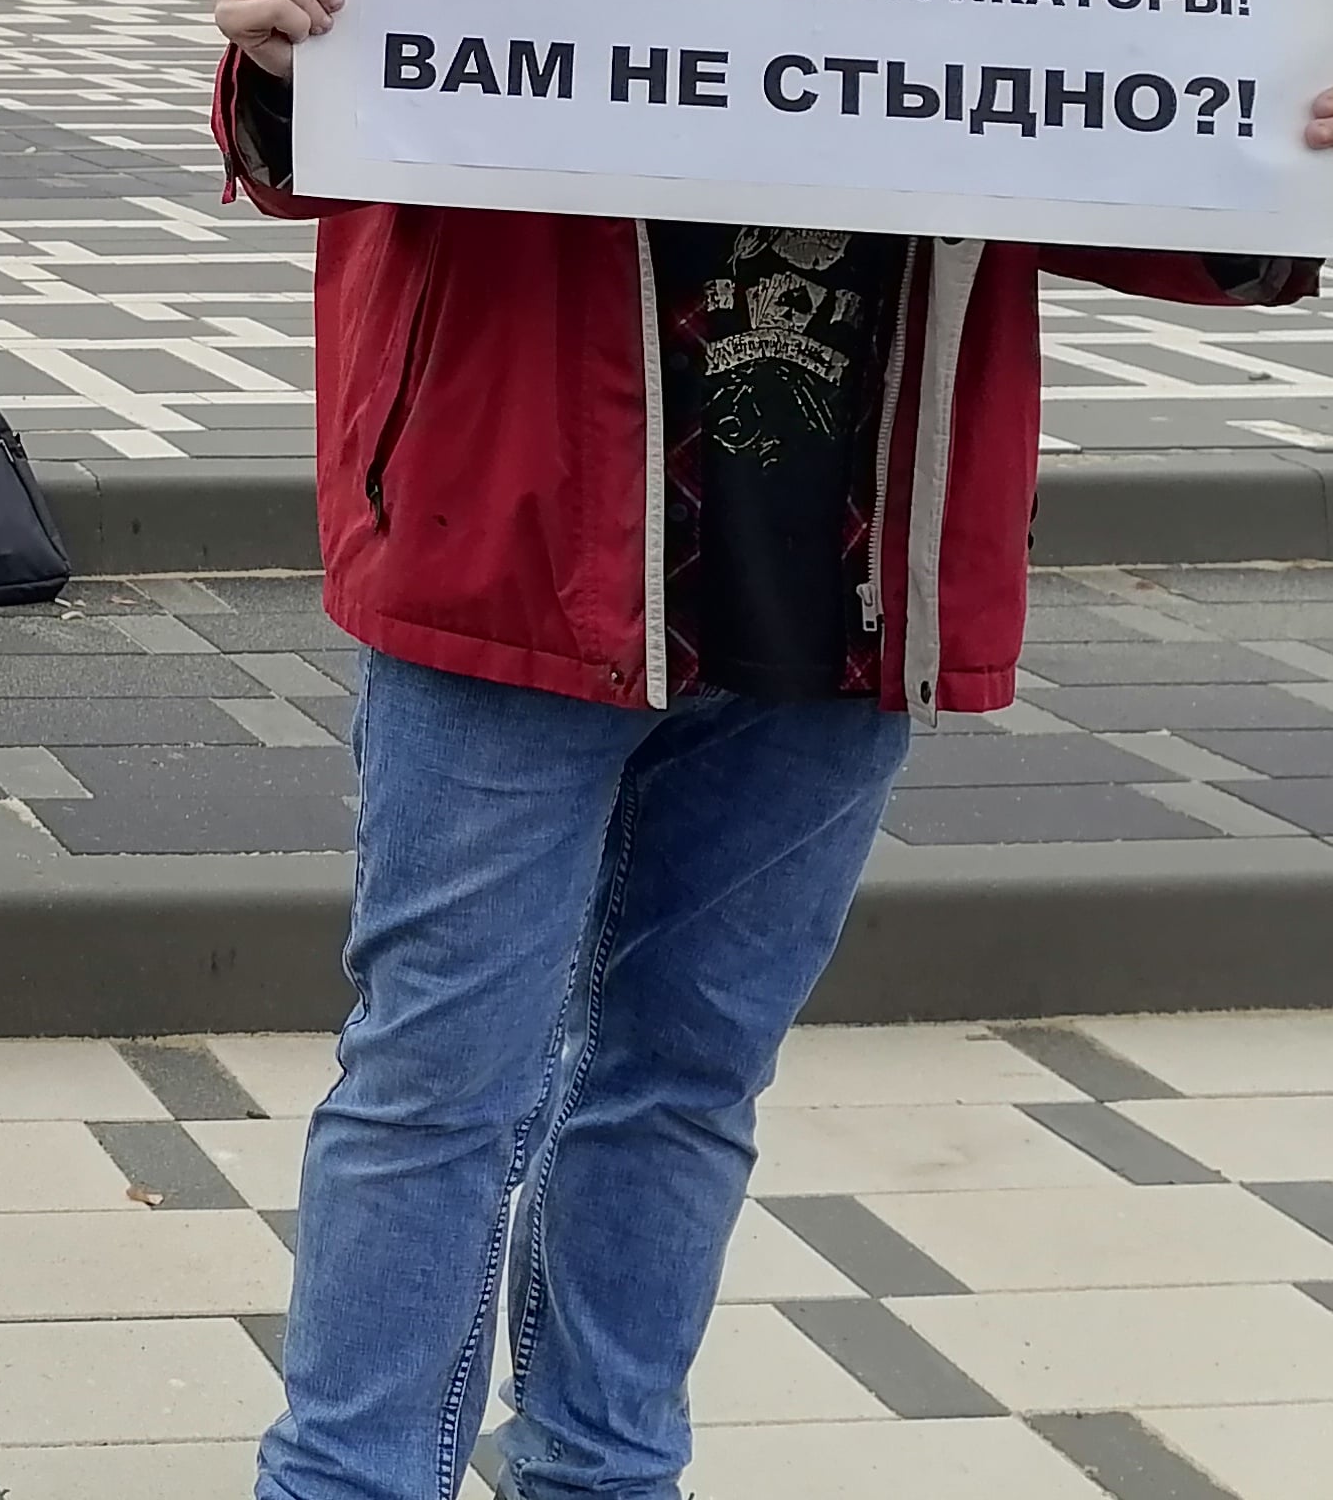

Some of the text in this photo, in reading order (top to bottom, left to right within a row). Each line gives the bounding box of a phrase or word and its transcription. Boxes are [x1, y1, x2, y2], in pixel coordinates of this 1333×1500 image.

[383, 32, 1257, 139] ВАМ НЕ СТЫДНО?!
